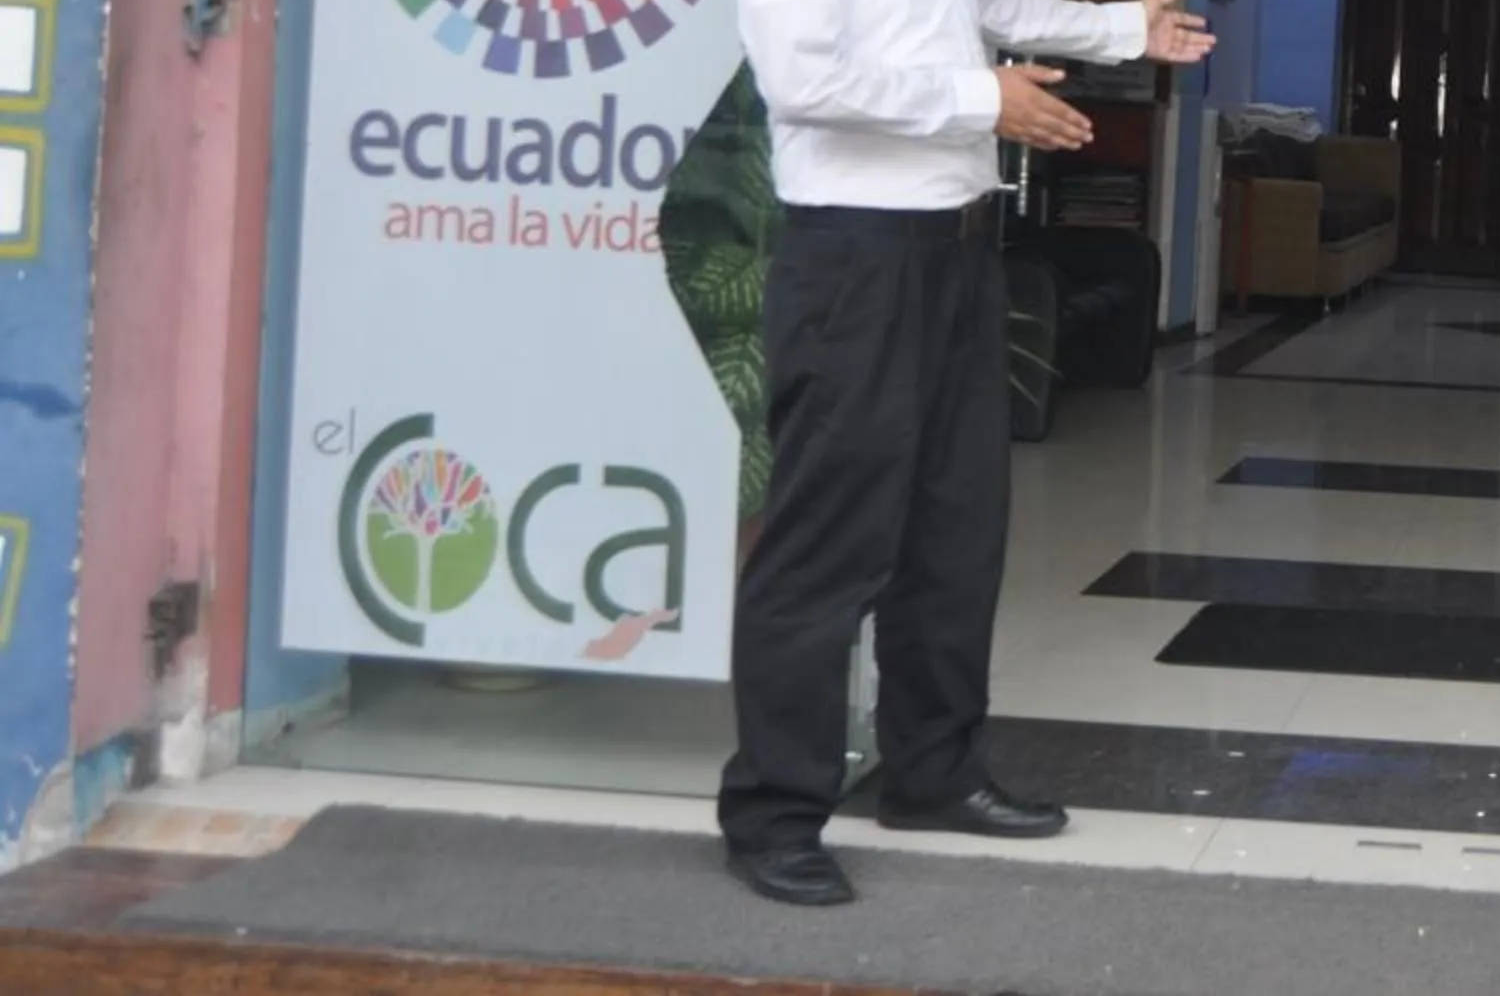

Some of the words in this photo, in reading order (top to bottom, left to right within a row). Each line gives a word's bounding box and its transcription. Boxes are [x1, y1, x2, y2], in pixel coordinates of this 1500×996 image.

[383, 201, 495, 241] ama
[507, 195, 549, 247] la
[561, 201, 662, 254] vida
[312, 407, 356, 456] el
